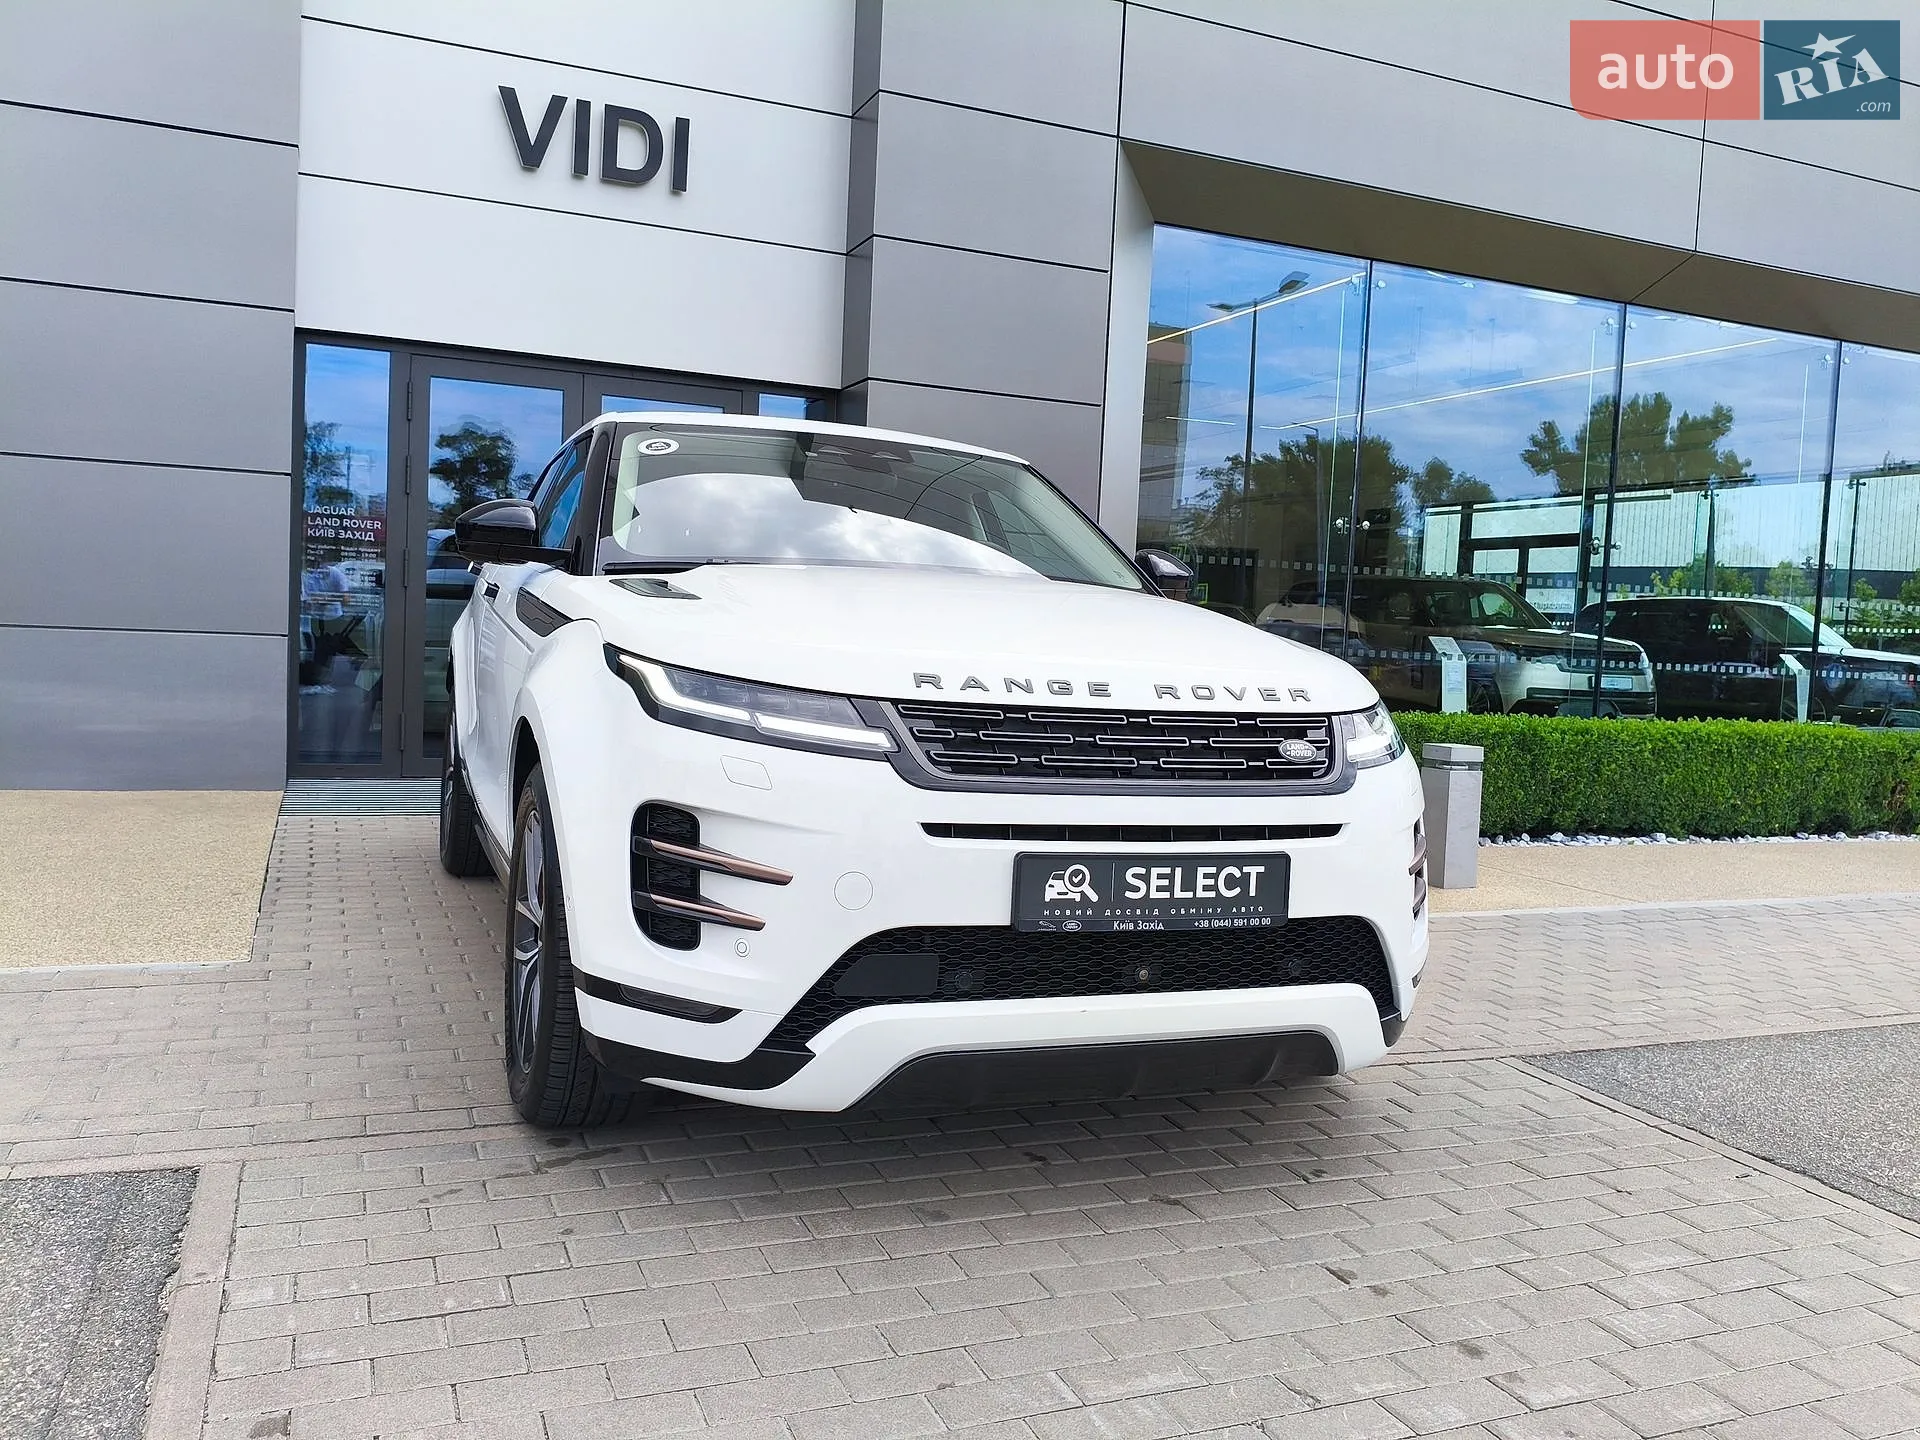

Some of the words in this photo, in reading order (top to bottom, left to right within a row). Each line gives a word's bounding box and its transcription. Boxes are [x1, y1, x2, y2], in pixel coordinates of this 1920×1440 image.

[497, 85, 691, 193] VIDI
[308, 505, 355, 516] JAGUAR
[307, 516, 340, 527] LAND
[342, 518, 382, 530] ROVER
[307, 526, 336, 538] КИЇВ
[337, 529, 375, 542] ЗАХІД
[912, 671, 1111, 697] RANGE
[1153, 683, 1312, 702] ROVER
[1290, 749, 1313, 757] ROVER
[1124, 866, 1265, 900] SELECT
[1043, 907, 1093, 916] НОВИЙ
[1104, 908, 1159, 916] ДОСВІД
[1170, 907, 1222, 915] ОБМІНУ
[1231, 905, 1264, 914] АВТО
[1113, 920, 1134, 931] Київ
[1137, 920, 1165, 931] Захід
[1194, 919, 1210, 928] +38
[1211, 918, 1232, 929] (044)
[1233, 918, 1248, 928] 591
[1249, 917, 1260, 927] 00
[1261, 917, 1271, 926] 00
